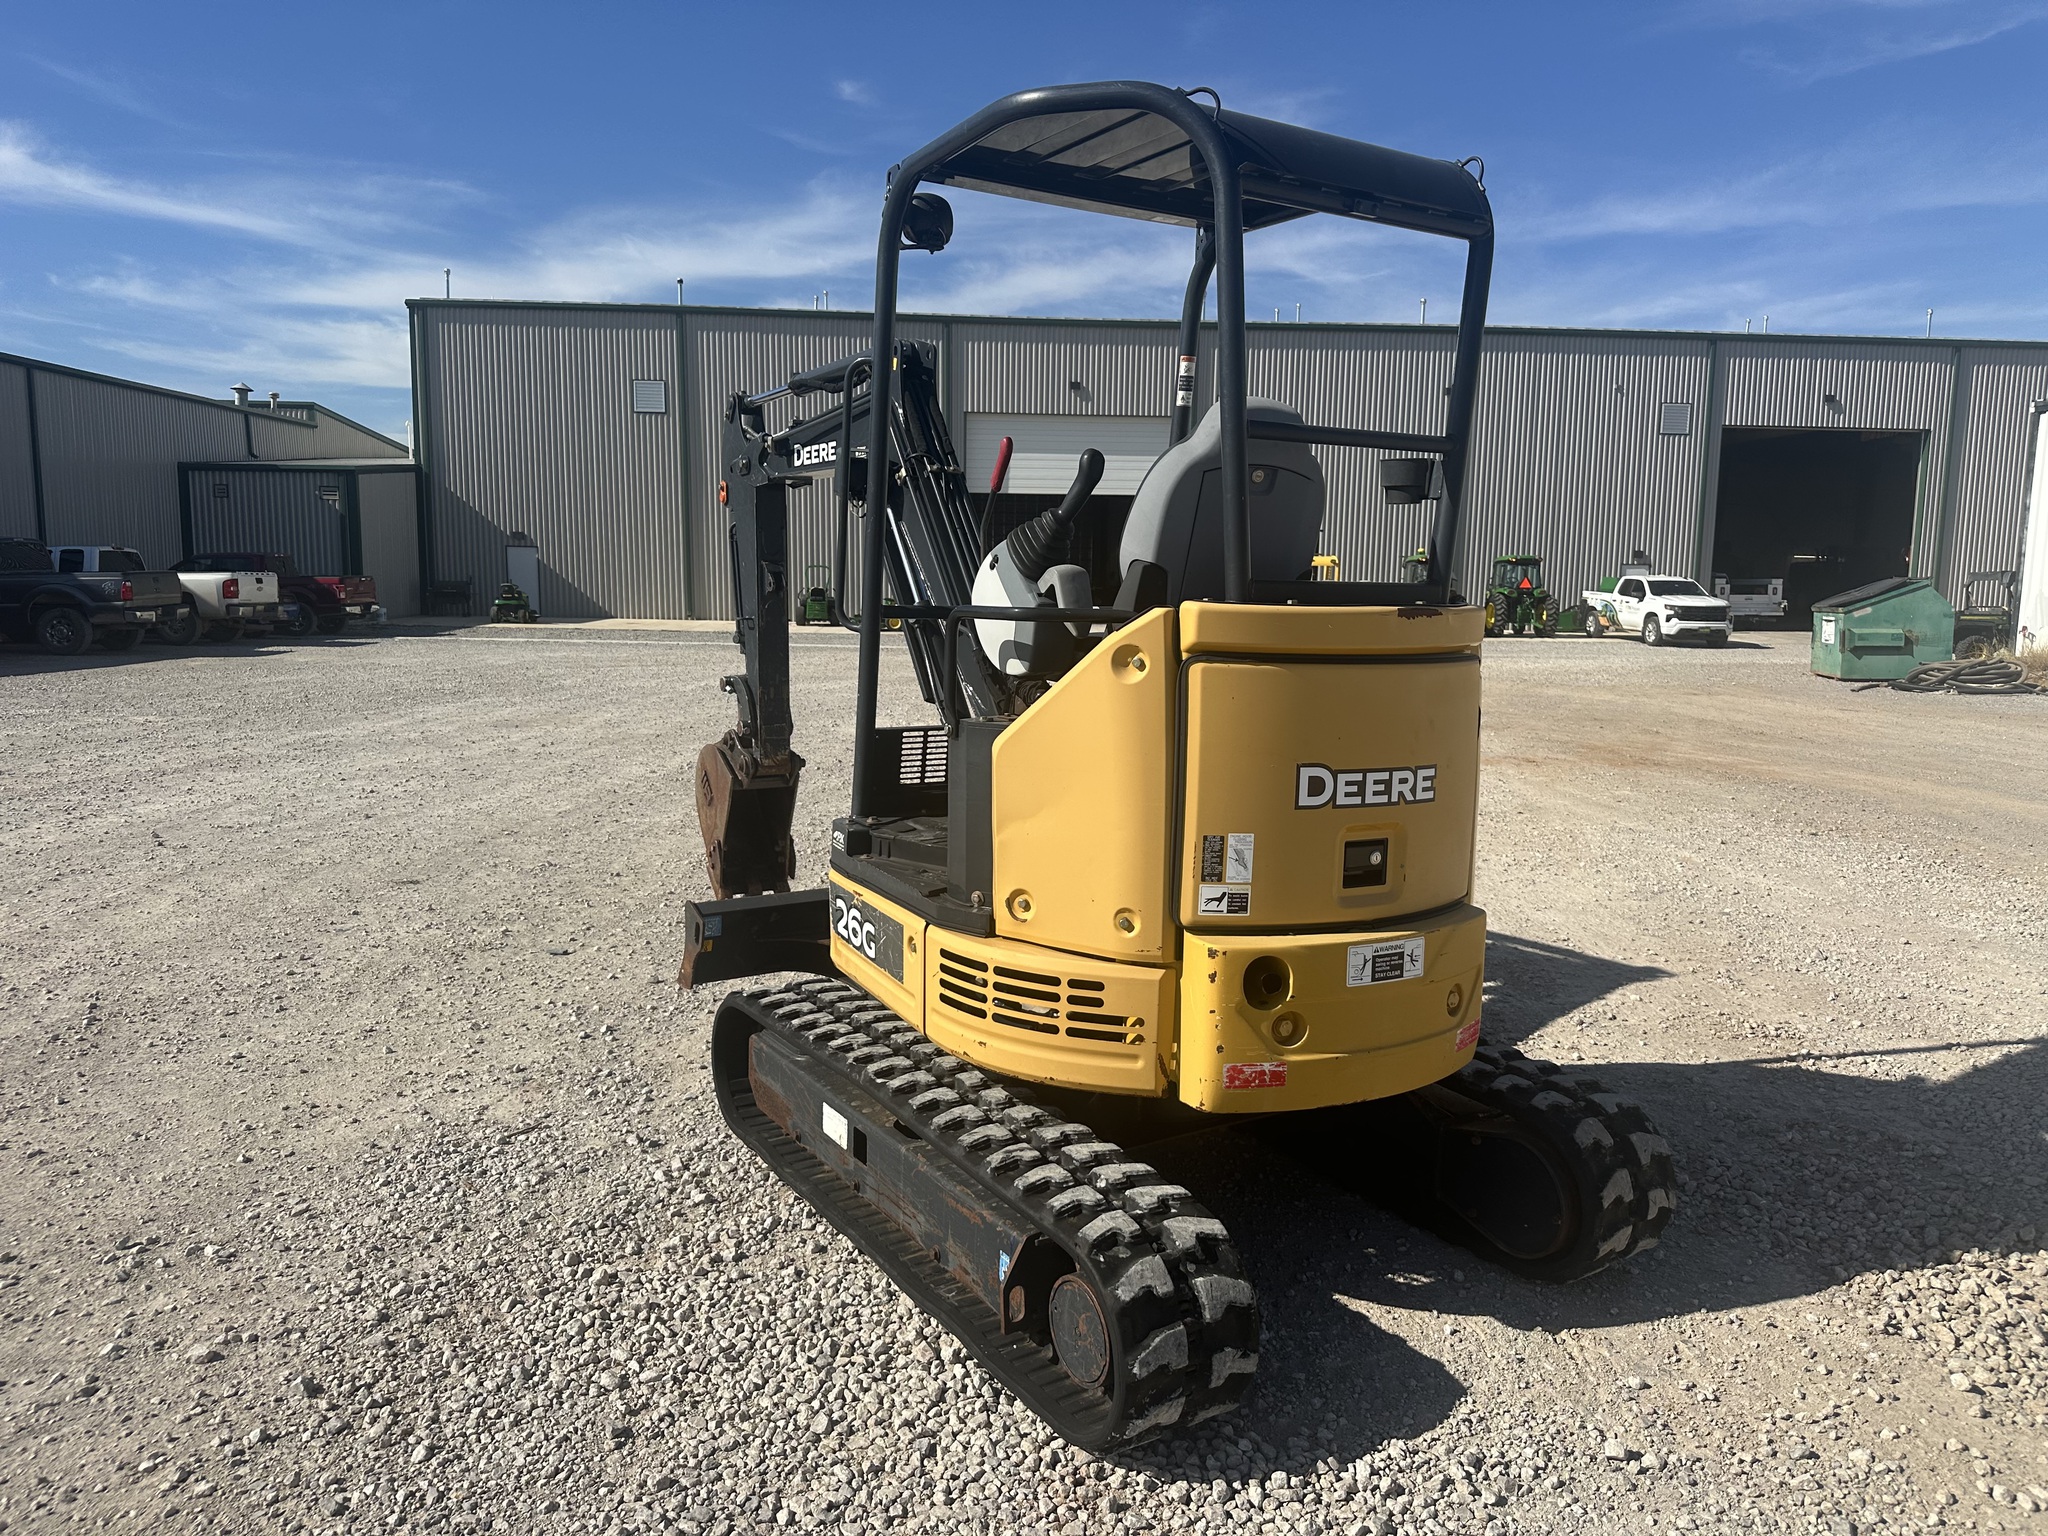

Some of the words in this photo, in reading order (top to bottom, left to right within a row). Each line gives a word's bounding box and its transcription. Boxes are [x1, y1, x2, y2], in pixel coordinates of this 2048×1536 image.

[793, 441, 837, 467] DEERE
[1297, 765, 1436, 807] DEERE
[835, 898, 876, 959] 26G
[1379, 943, 1404, 952] WARNING
